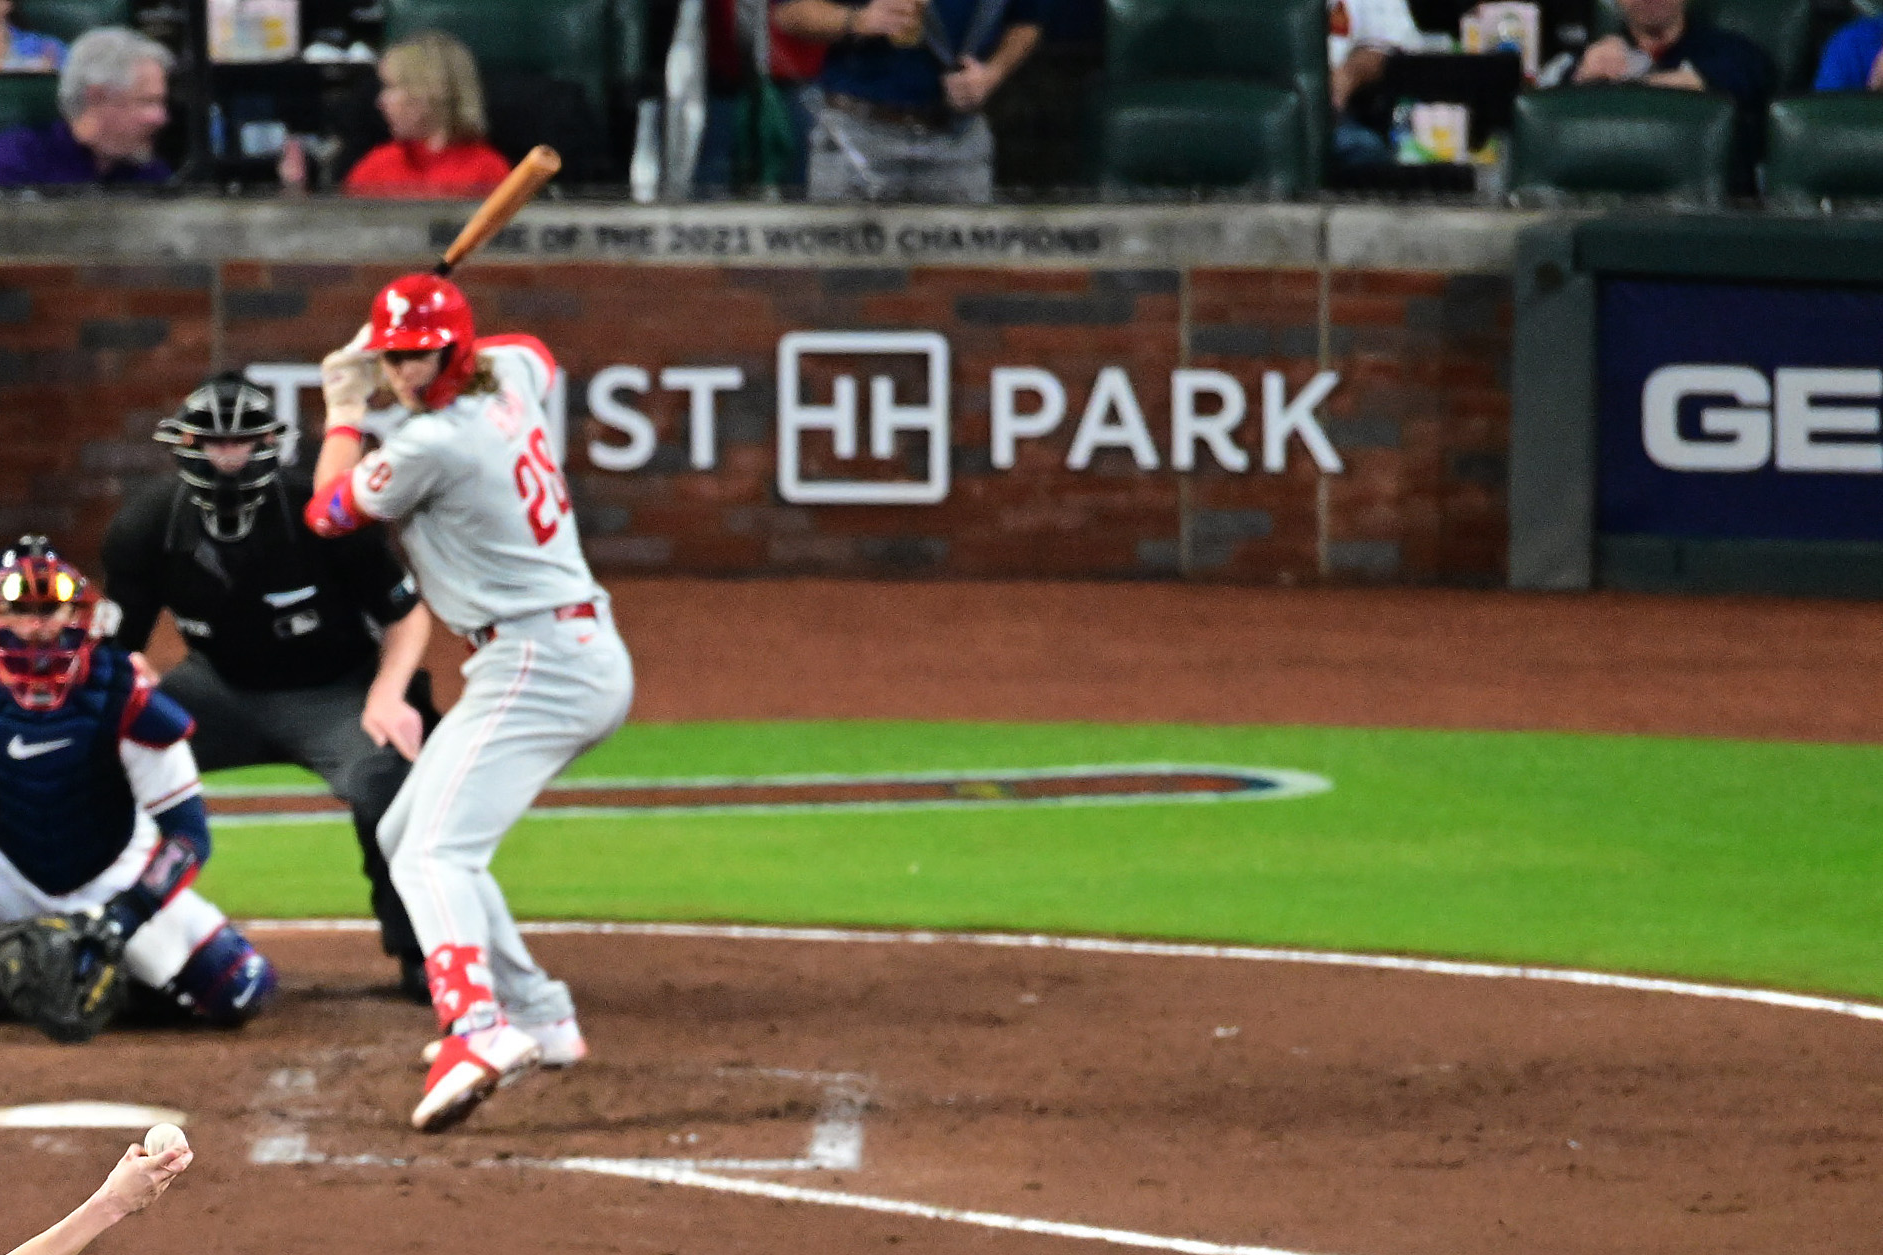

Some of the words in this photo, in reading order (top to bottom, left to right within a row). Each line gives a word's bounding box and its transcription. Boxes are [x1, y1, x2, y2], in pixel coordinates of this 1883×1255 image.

[666, 223, 751, 256] 2021
[763, 221, 885, 256] WORLD
[894, 223, 1102, 256] CHAMPIONS
[989, 365, 1342, 473] PARK
